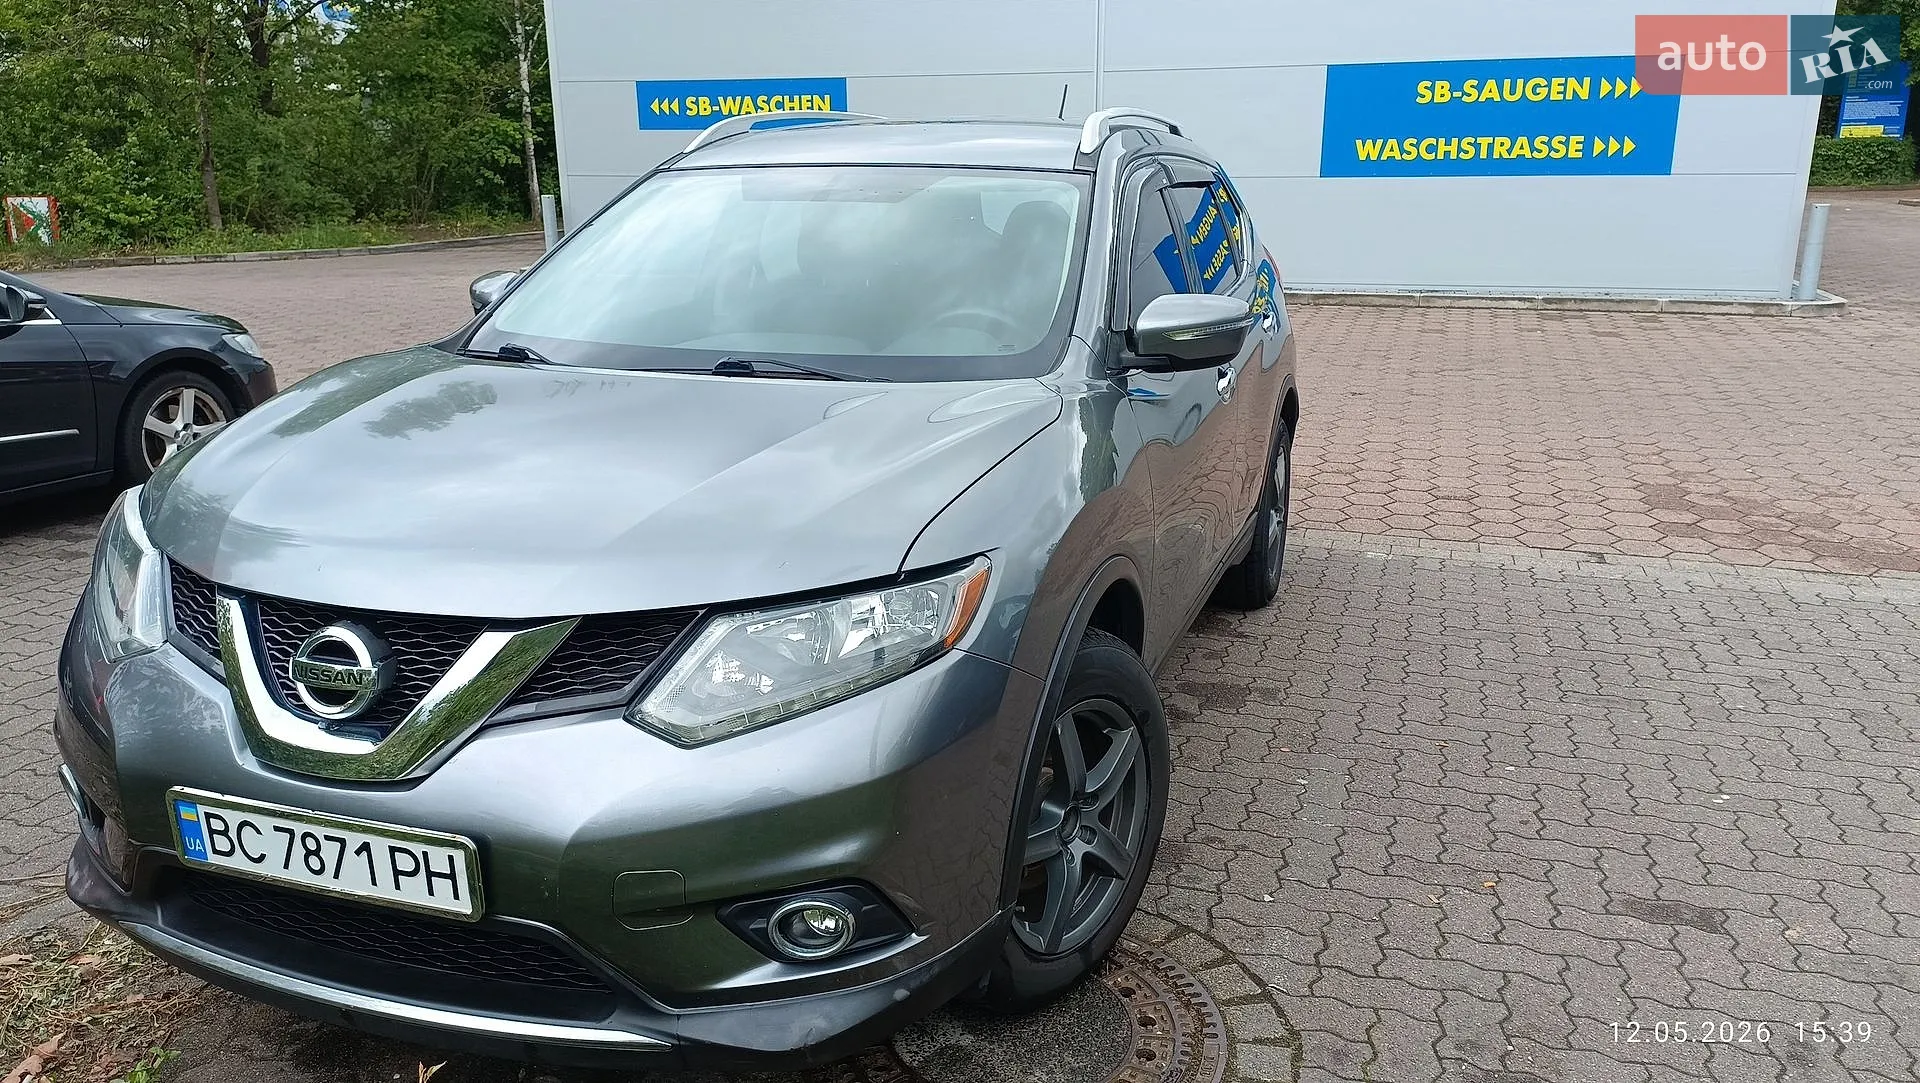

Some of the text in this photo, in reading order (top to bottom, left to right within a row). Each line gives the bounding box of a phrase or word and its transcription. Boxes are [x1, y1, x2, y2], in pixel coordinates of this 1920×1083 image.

[1415, 77, 1591, 104] SB-SAUGEN
[685, 94, 831, 116] SB-WASCHEN
[1355, 136, 1585, 161] WASCHSTRASSE
[293, 664, 363, 687] NISSAN
[185, 837, 204, 852] UA
[203, 811, 461, 901] BC 7871 PH
